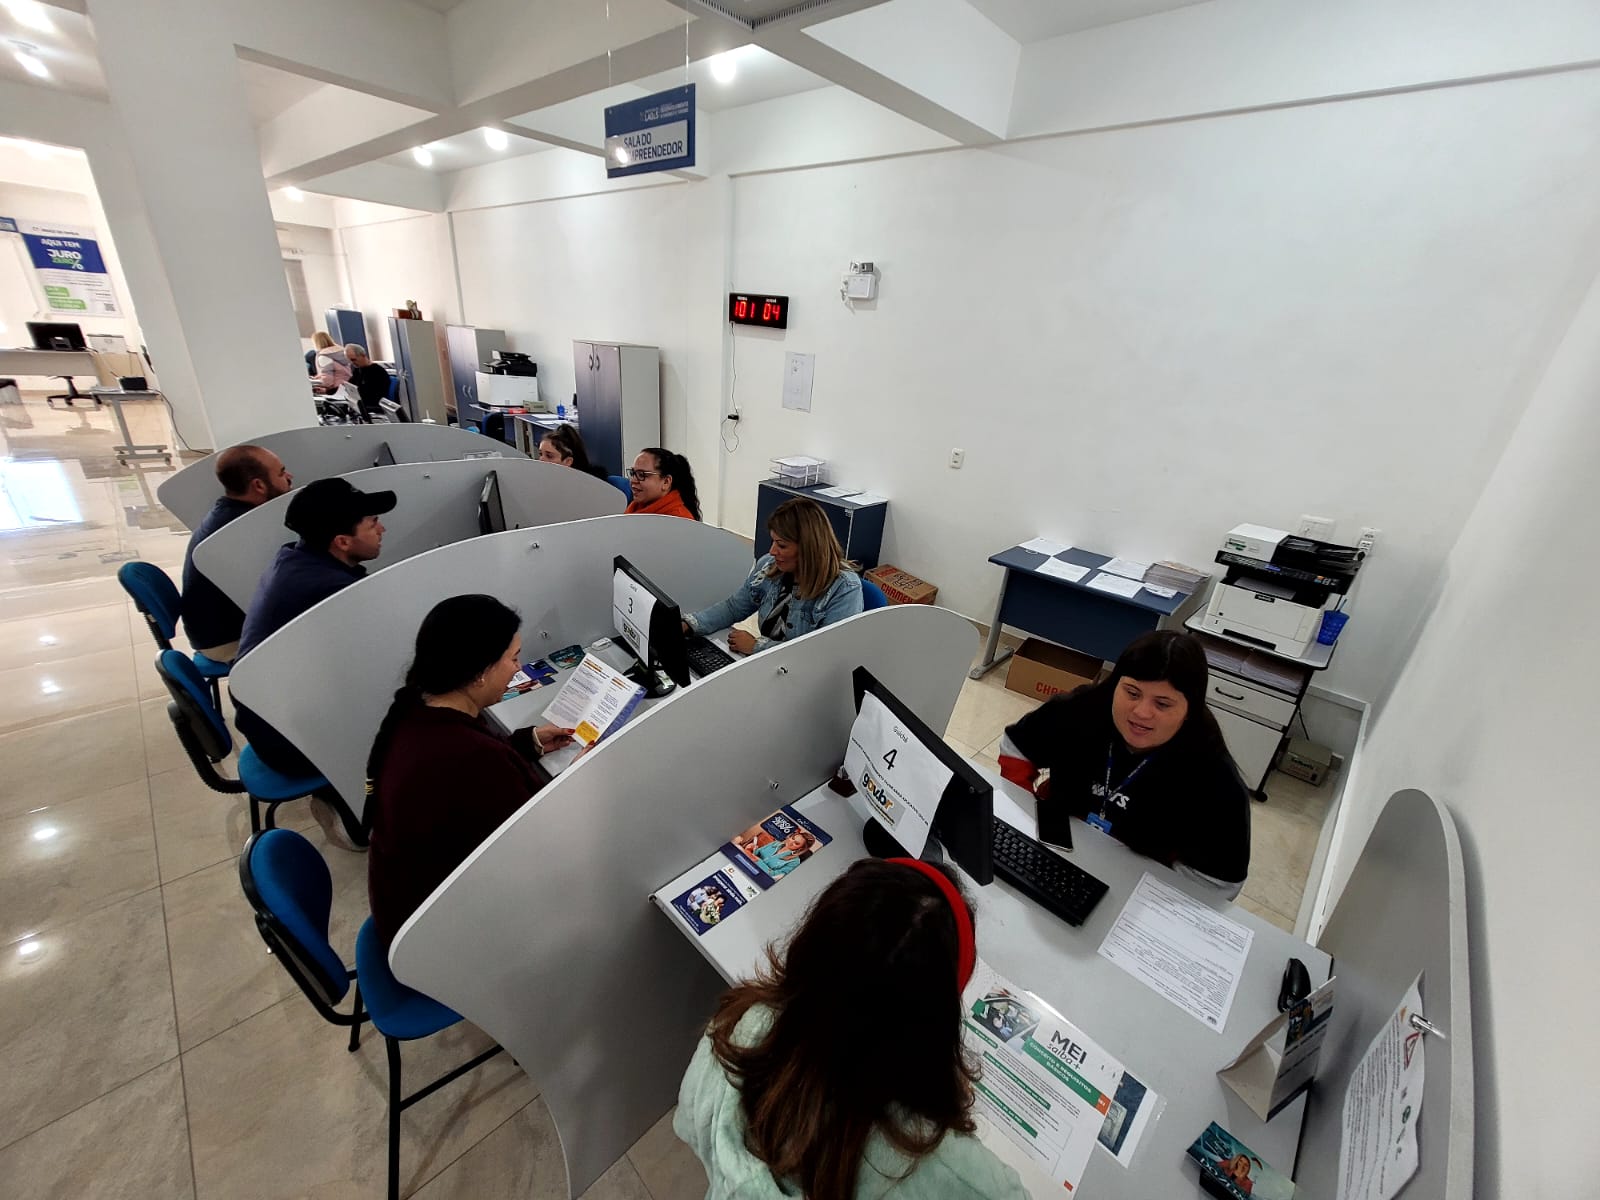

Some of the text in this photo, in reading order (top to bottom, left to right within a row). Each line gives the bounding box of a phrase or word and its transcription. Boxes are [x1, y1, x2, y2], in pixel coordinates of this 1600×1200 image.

[624, 132, 652, 149] SALA DO
[46, 248, 82, 260] JURO
[763, 303, 781, 320] 04
[628, 597, 634, 614] 3
[883, 749, 898, 770] 4
[1051, 1030, 1087, 1064] MEI
[1029, 1042, 1056, 1064] CONCEITO
[1060, 1065, 1092, 1093] REQUISITOS
